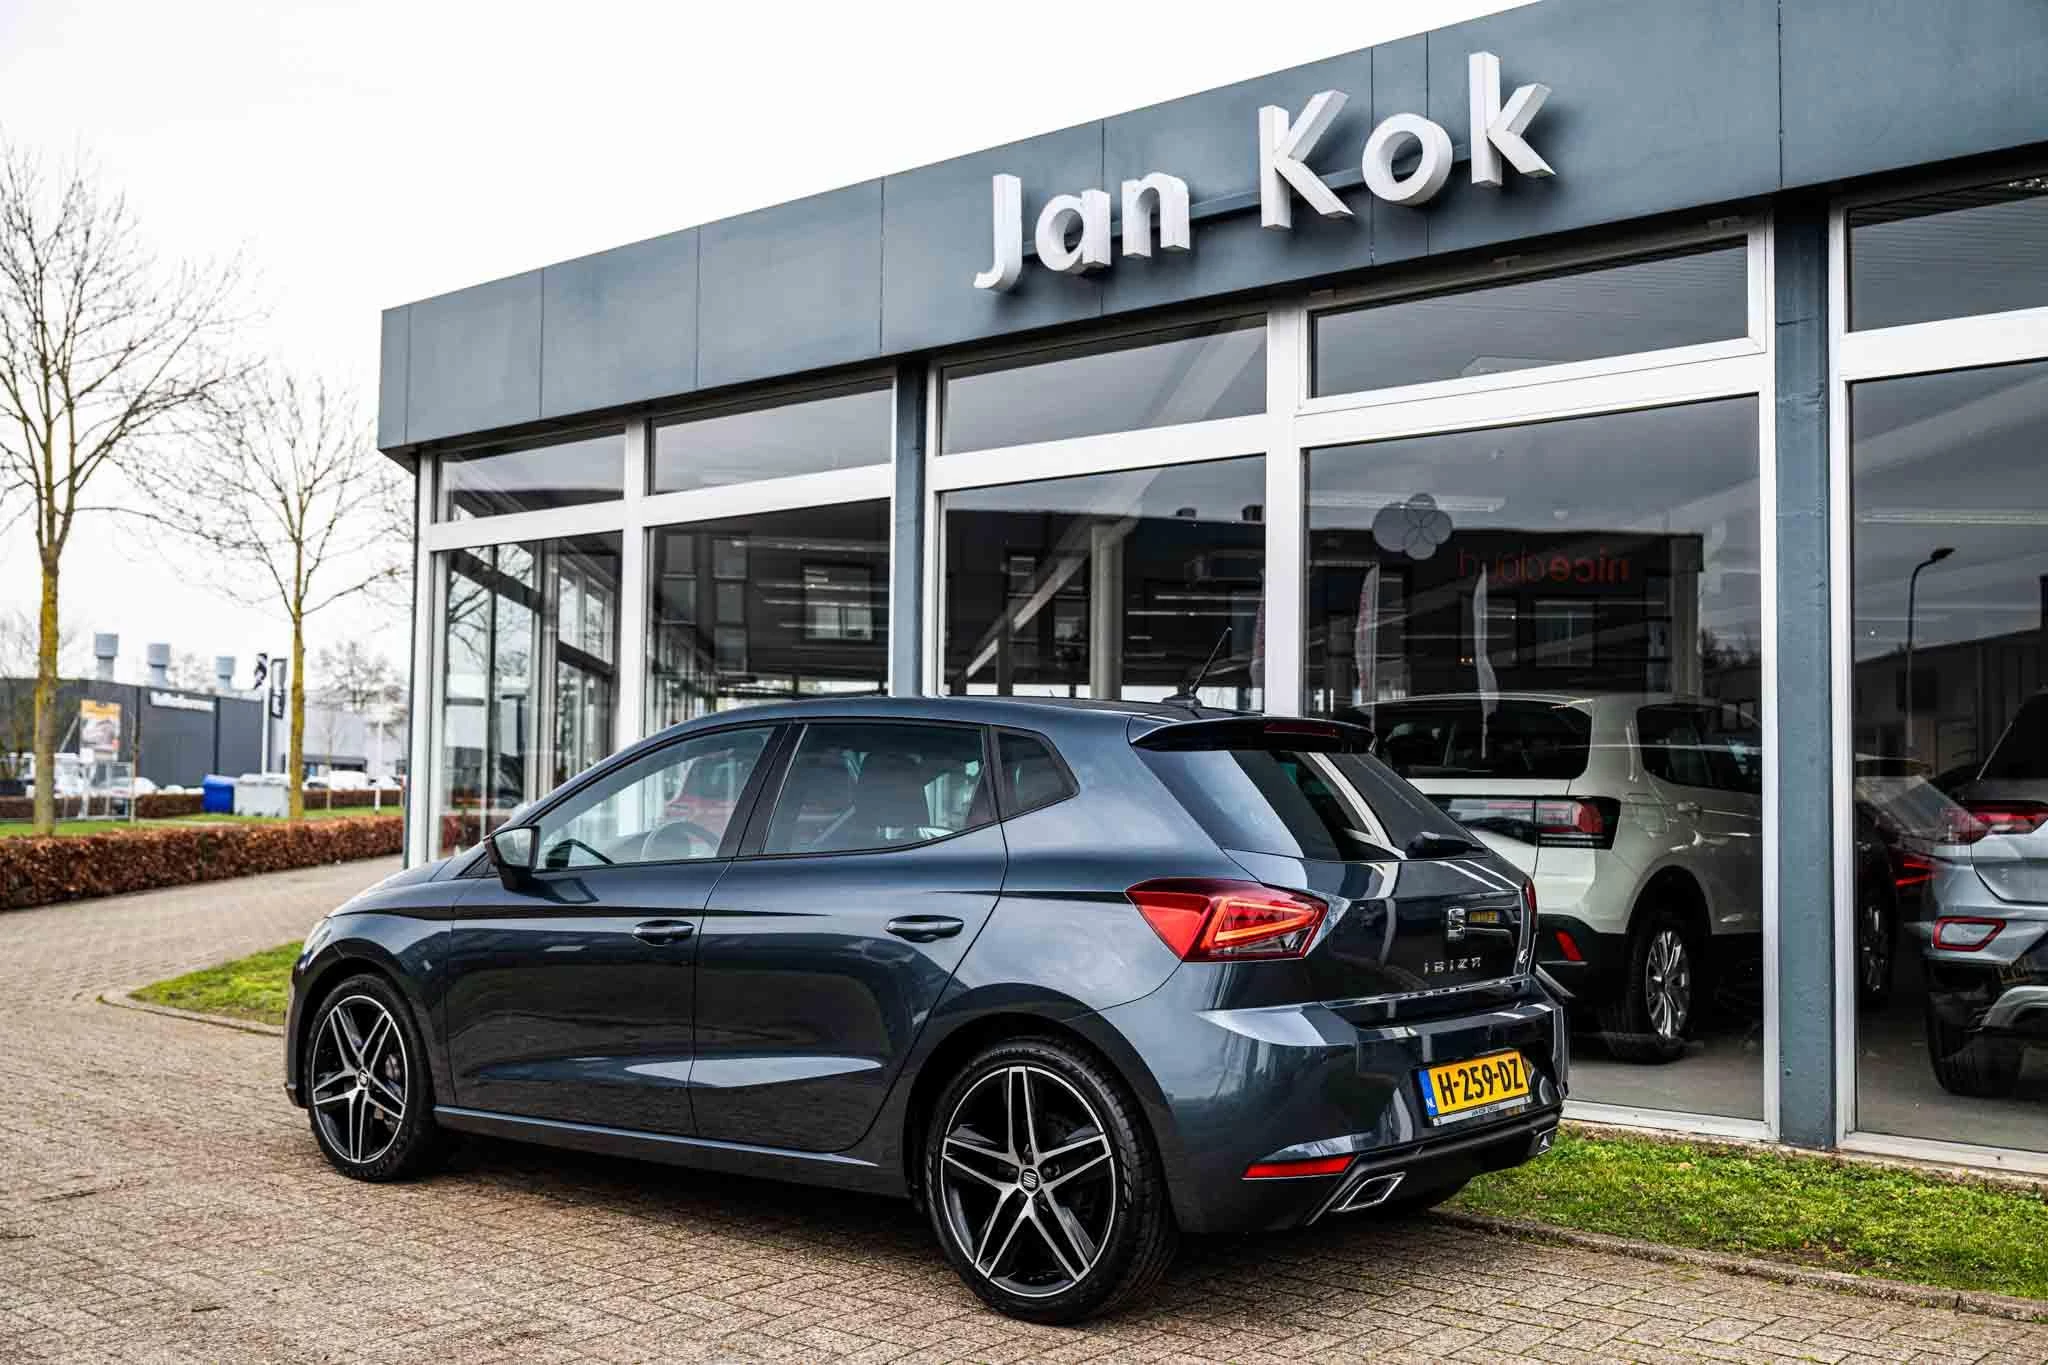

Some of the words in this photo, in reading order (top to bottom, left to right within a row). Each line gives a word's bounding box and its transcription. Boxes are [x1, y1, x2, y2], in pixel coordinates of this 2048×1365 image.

[974, 171, 1191, 291] Jan
[1258, 51, 1556, 230] Kok
[1437, 1058, 1523, 1107] H-259-DZ
